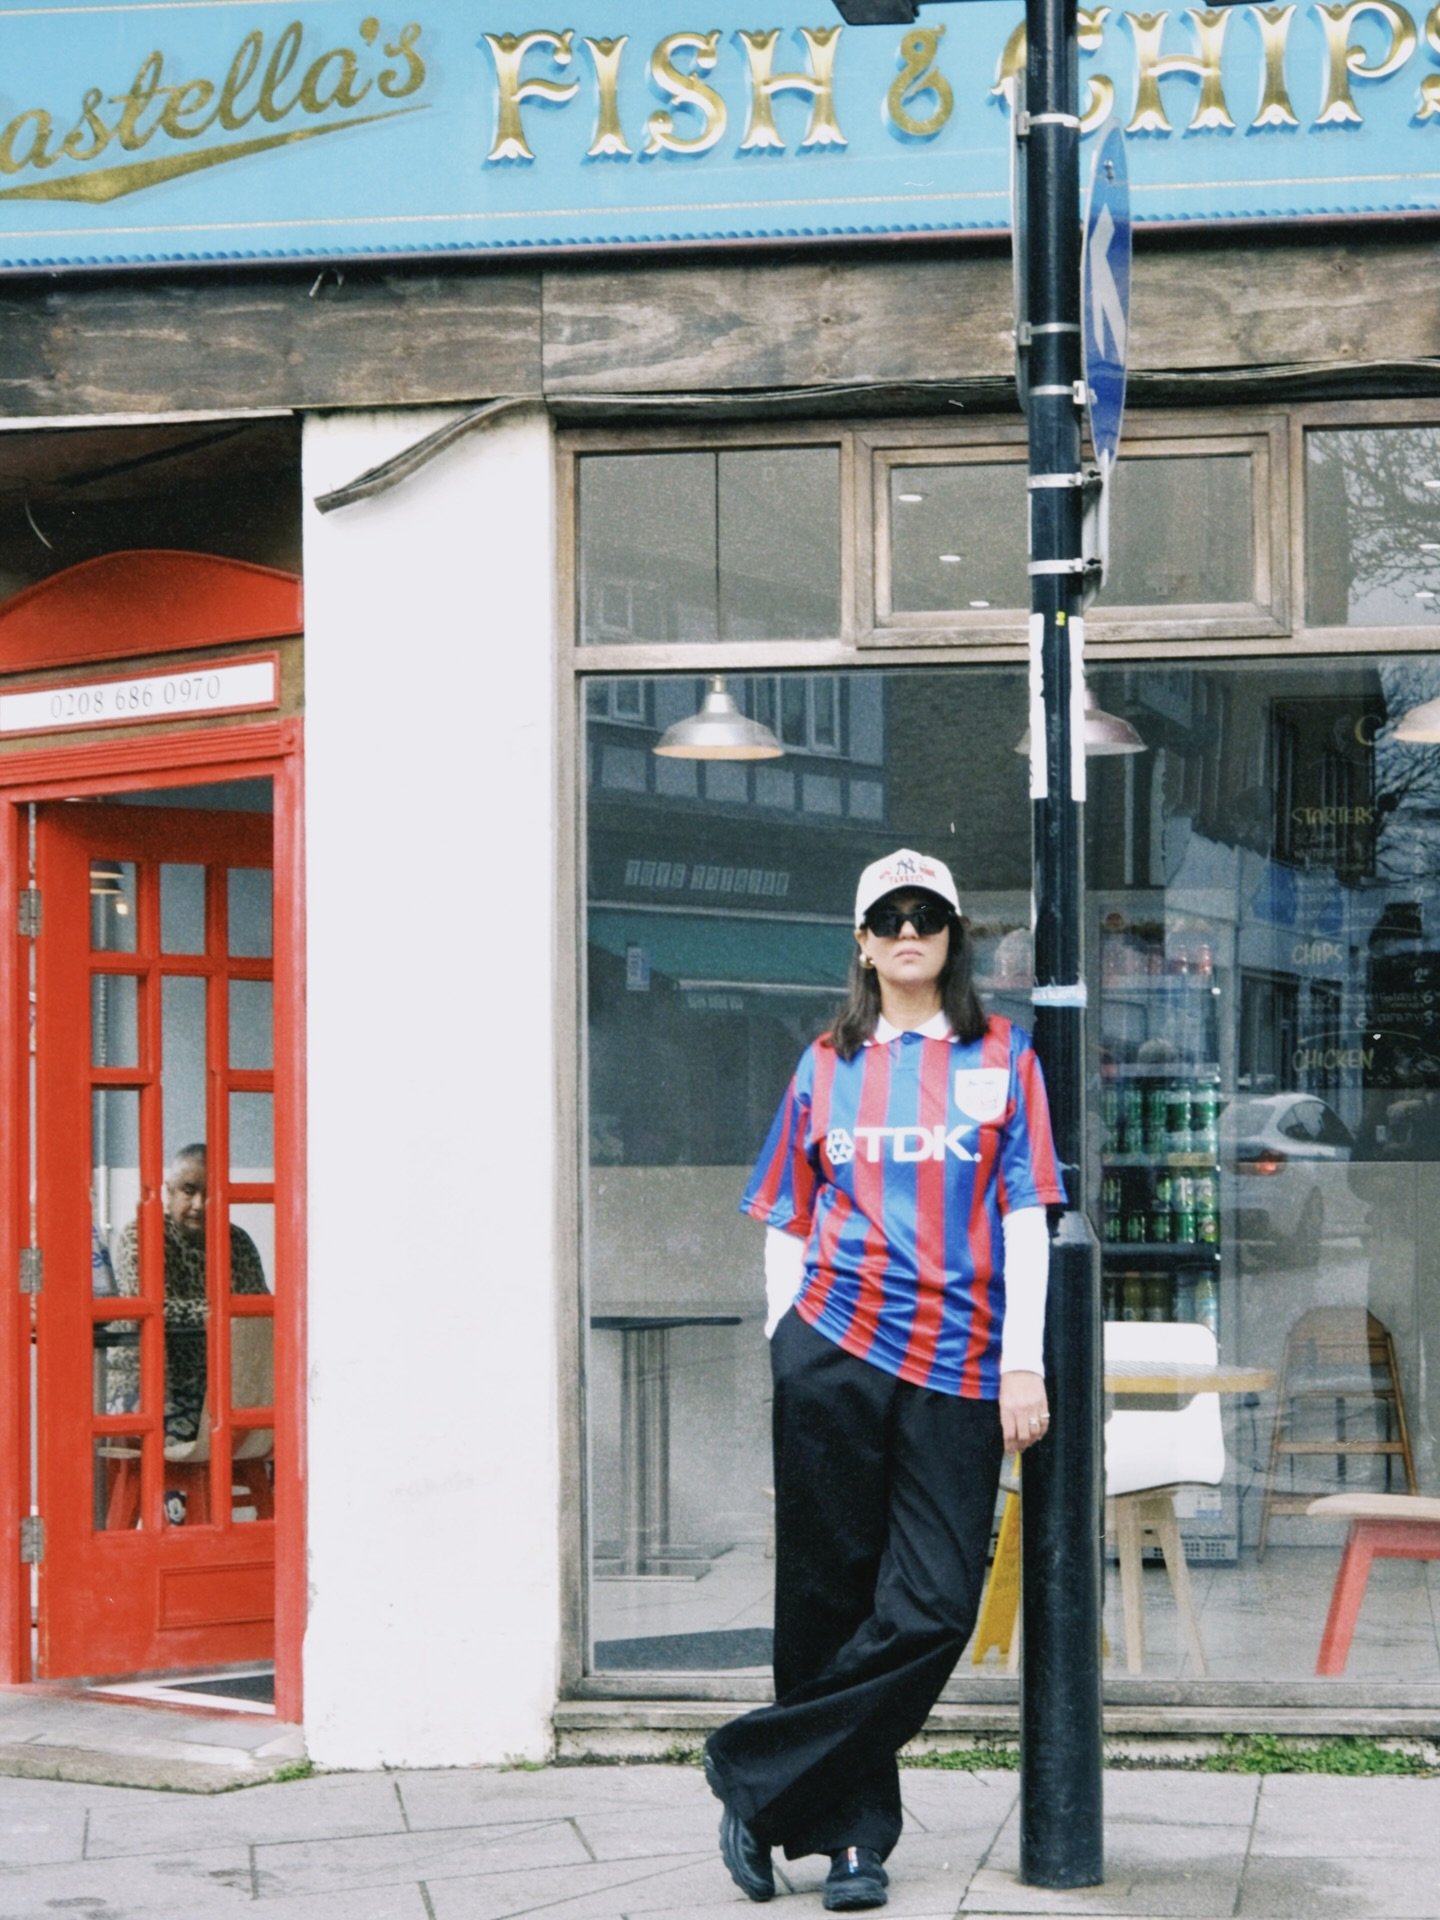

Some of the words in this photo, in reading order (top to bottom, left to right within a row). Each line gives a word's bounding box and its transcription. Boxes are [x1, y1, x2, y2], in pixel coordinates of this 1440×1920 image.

[482, 25, 848, 161] FISH
[886, 23, 953, 137] &
[50, 691, 104, 719] 0208
[115, 684, 153, 712] 686
[163, 674, 221, 706] 0970
[1291, 806, 1374, 825] STARTERS
[1292, 940, 1344, 965] CHIPS
[1292, 1047, 1375, 1073] CHICKEN
